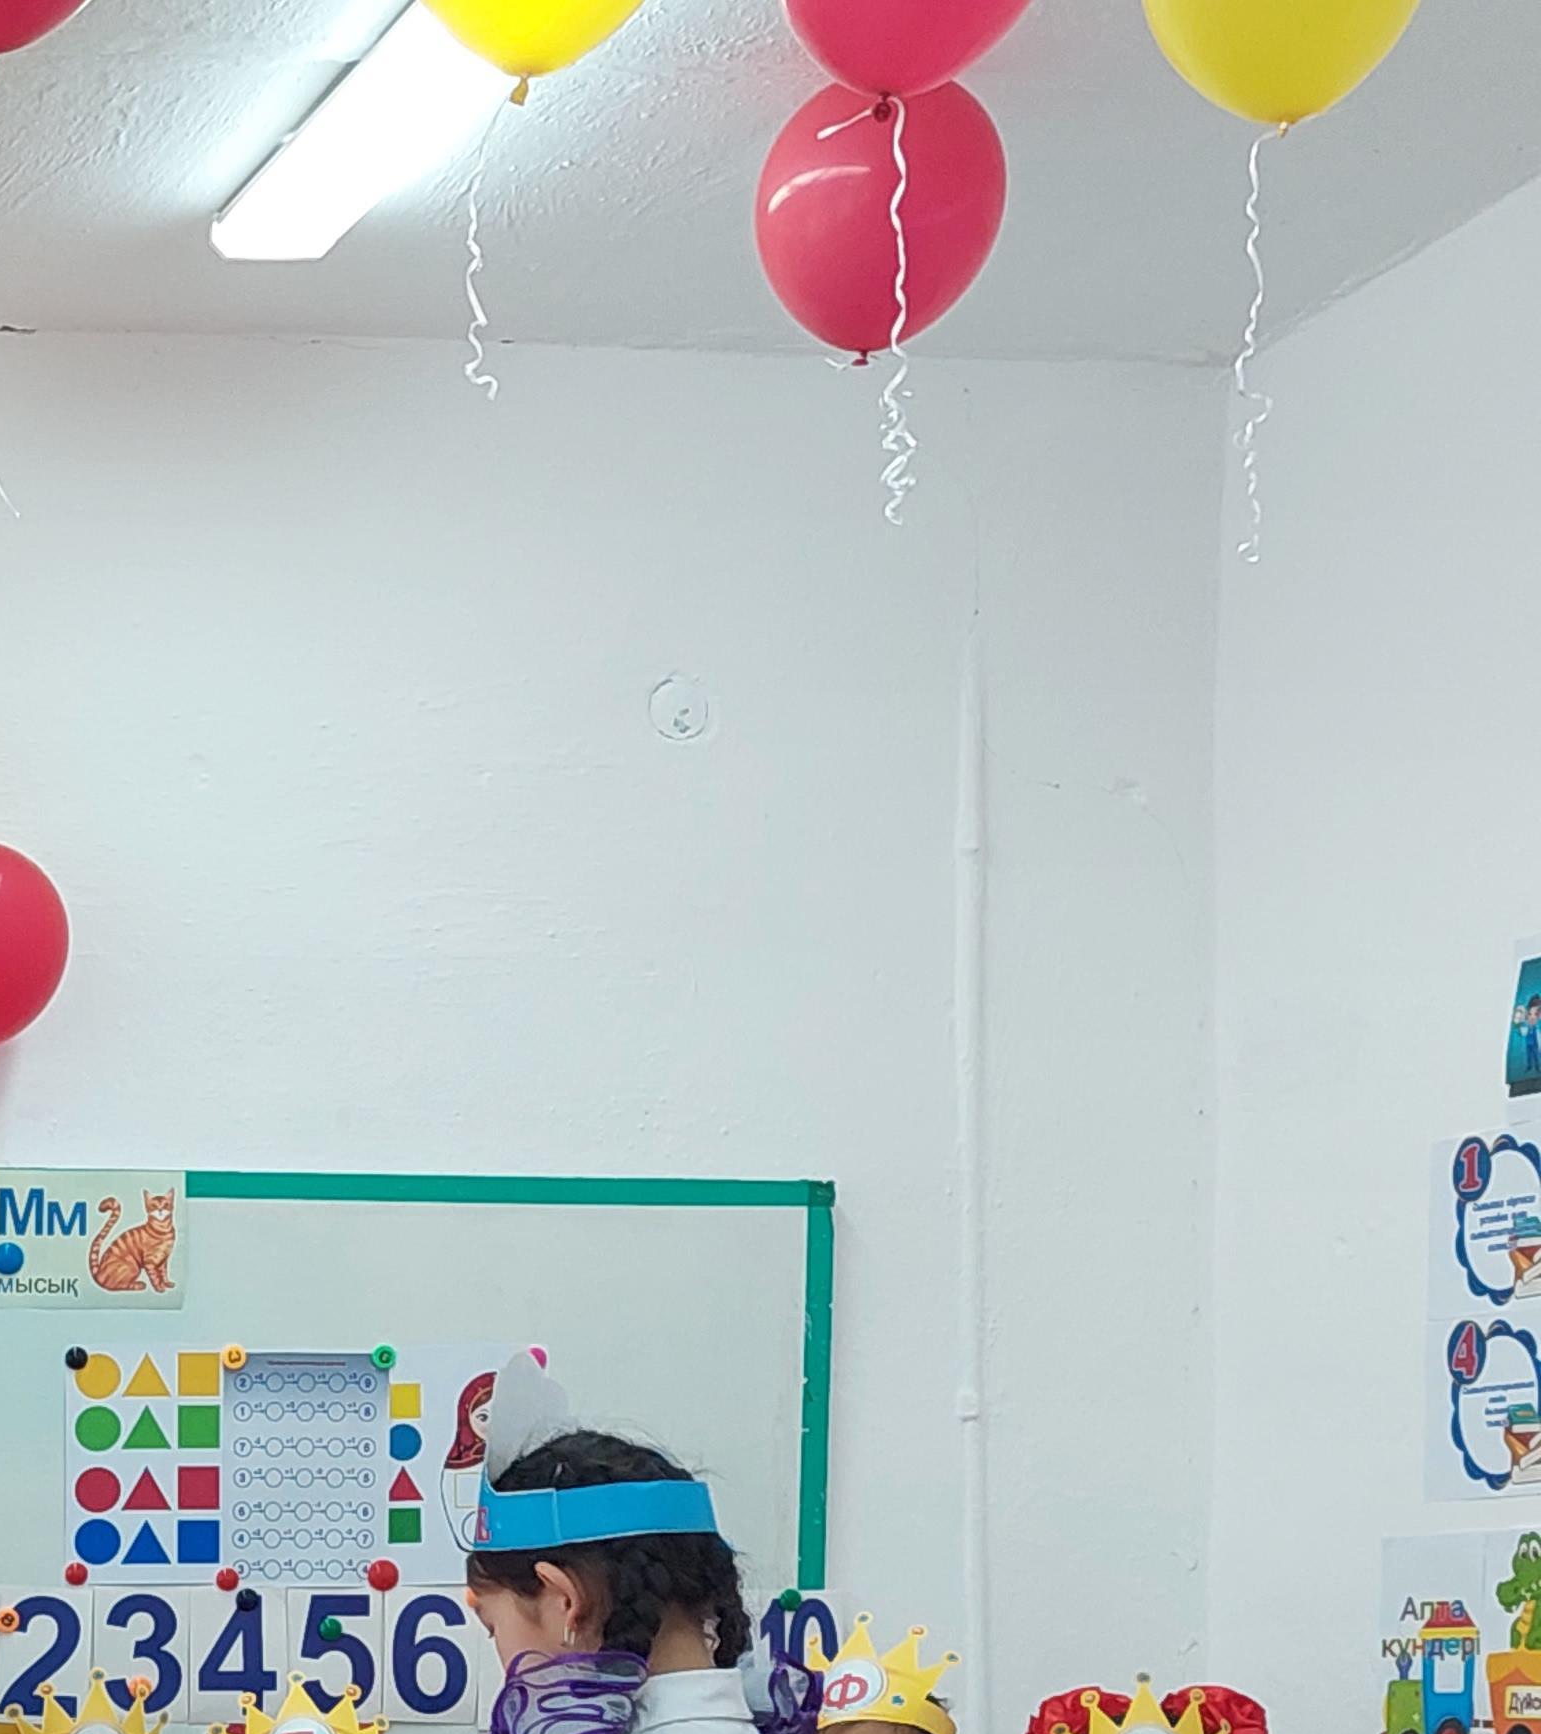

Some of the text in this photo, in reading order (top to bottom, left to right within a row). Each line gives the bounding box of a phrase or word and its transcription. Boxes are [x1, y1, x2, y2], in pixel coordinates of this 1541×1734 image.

[1459, 1144, 1482, 1192] 1
[1453, 1322, 1479, 1378] 4
[1399, 1597, 1466, 1622] Апта
[392, 1594, 469, 1716] 6
